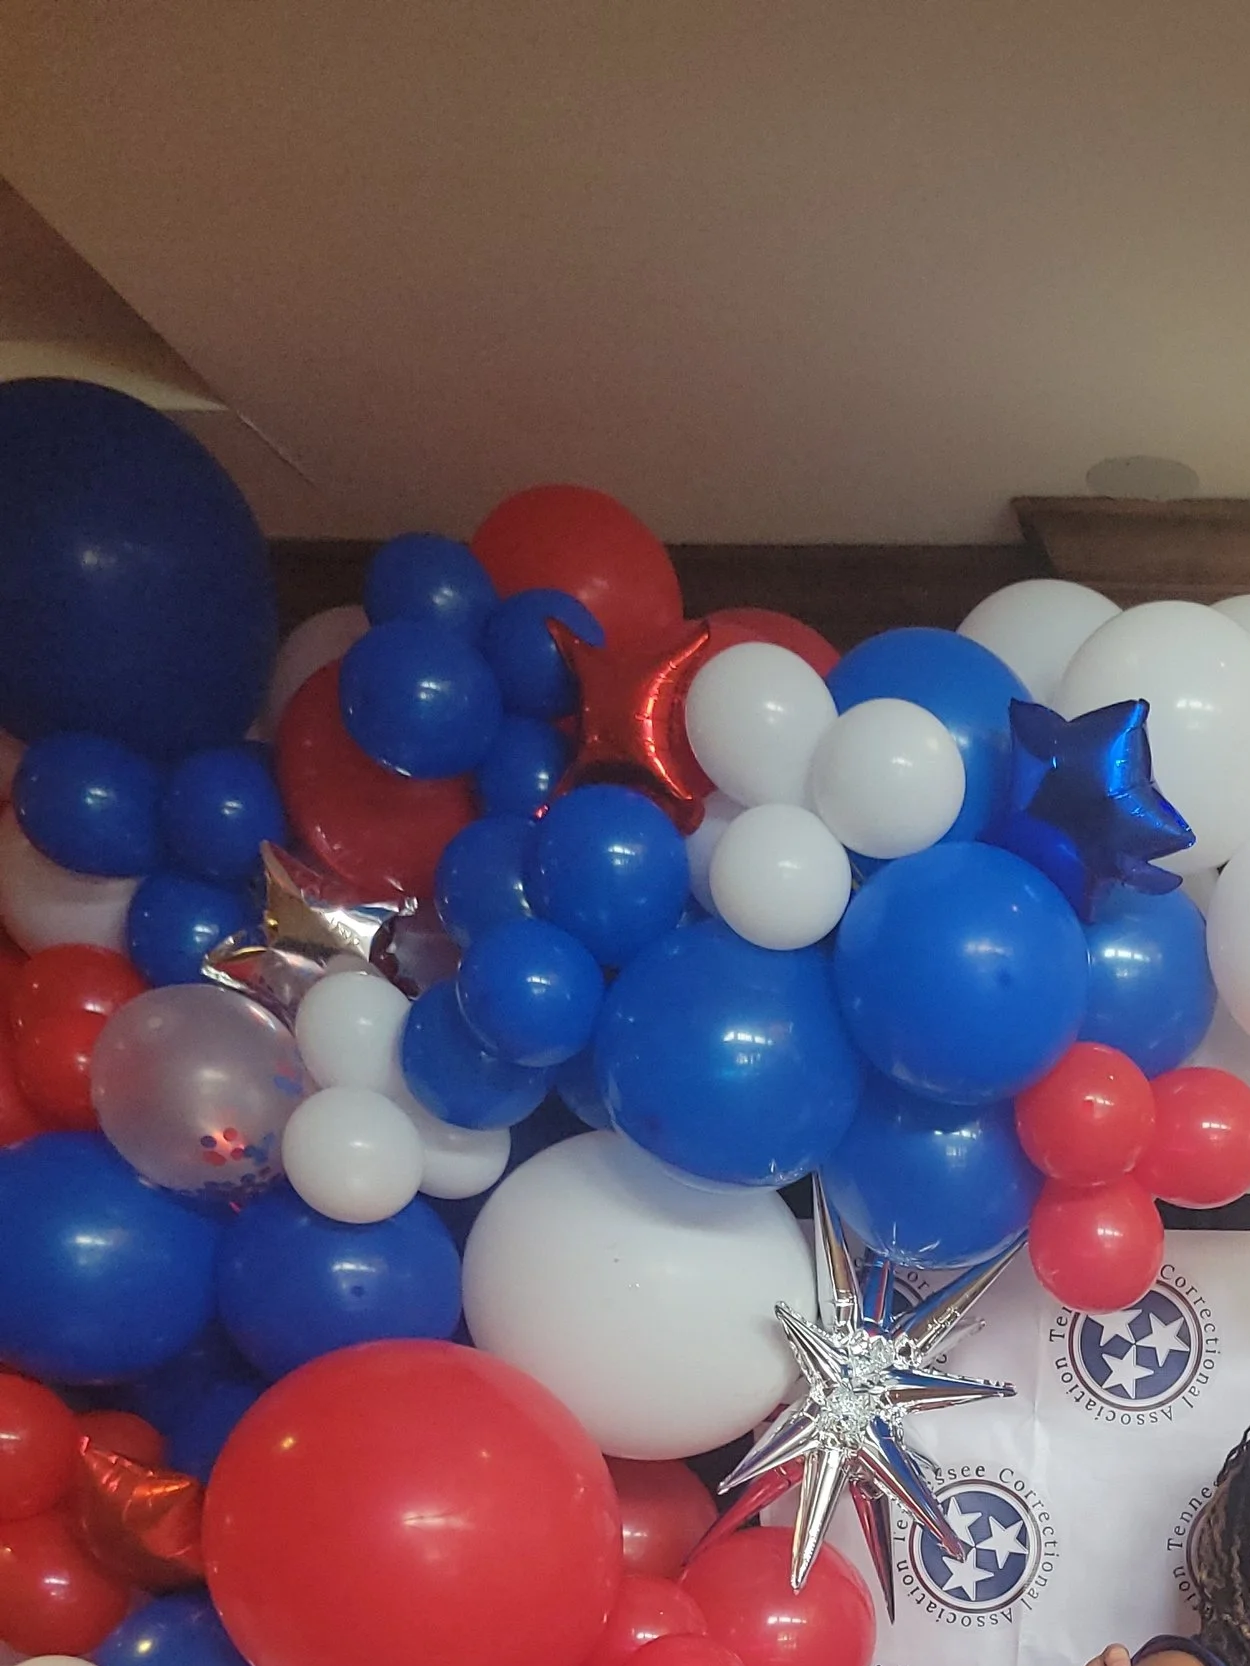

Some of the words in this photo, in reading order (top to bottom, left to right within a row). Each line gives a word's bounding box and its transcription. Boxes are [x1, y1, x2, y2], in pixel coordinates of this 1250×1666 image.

[1160, 1264, 1221, 1408] Correctional
[1055, 1357, 1173, 1425] Association
[999, 1468, 1059, 1611] Correctional
[1167, 1484, 1214, 1551] Tenne
[896, 1559, 1013, 1627] Association
